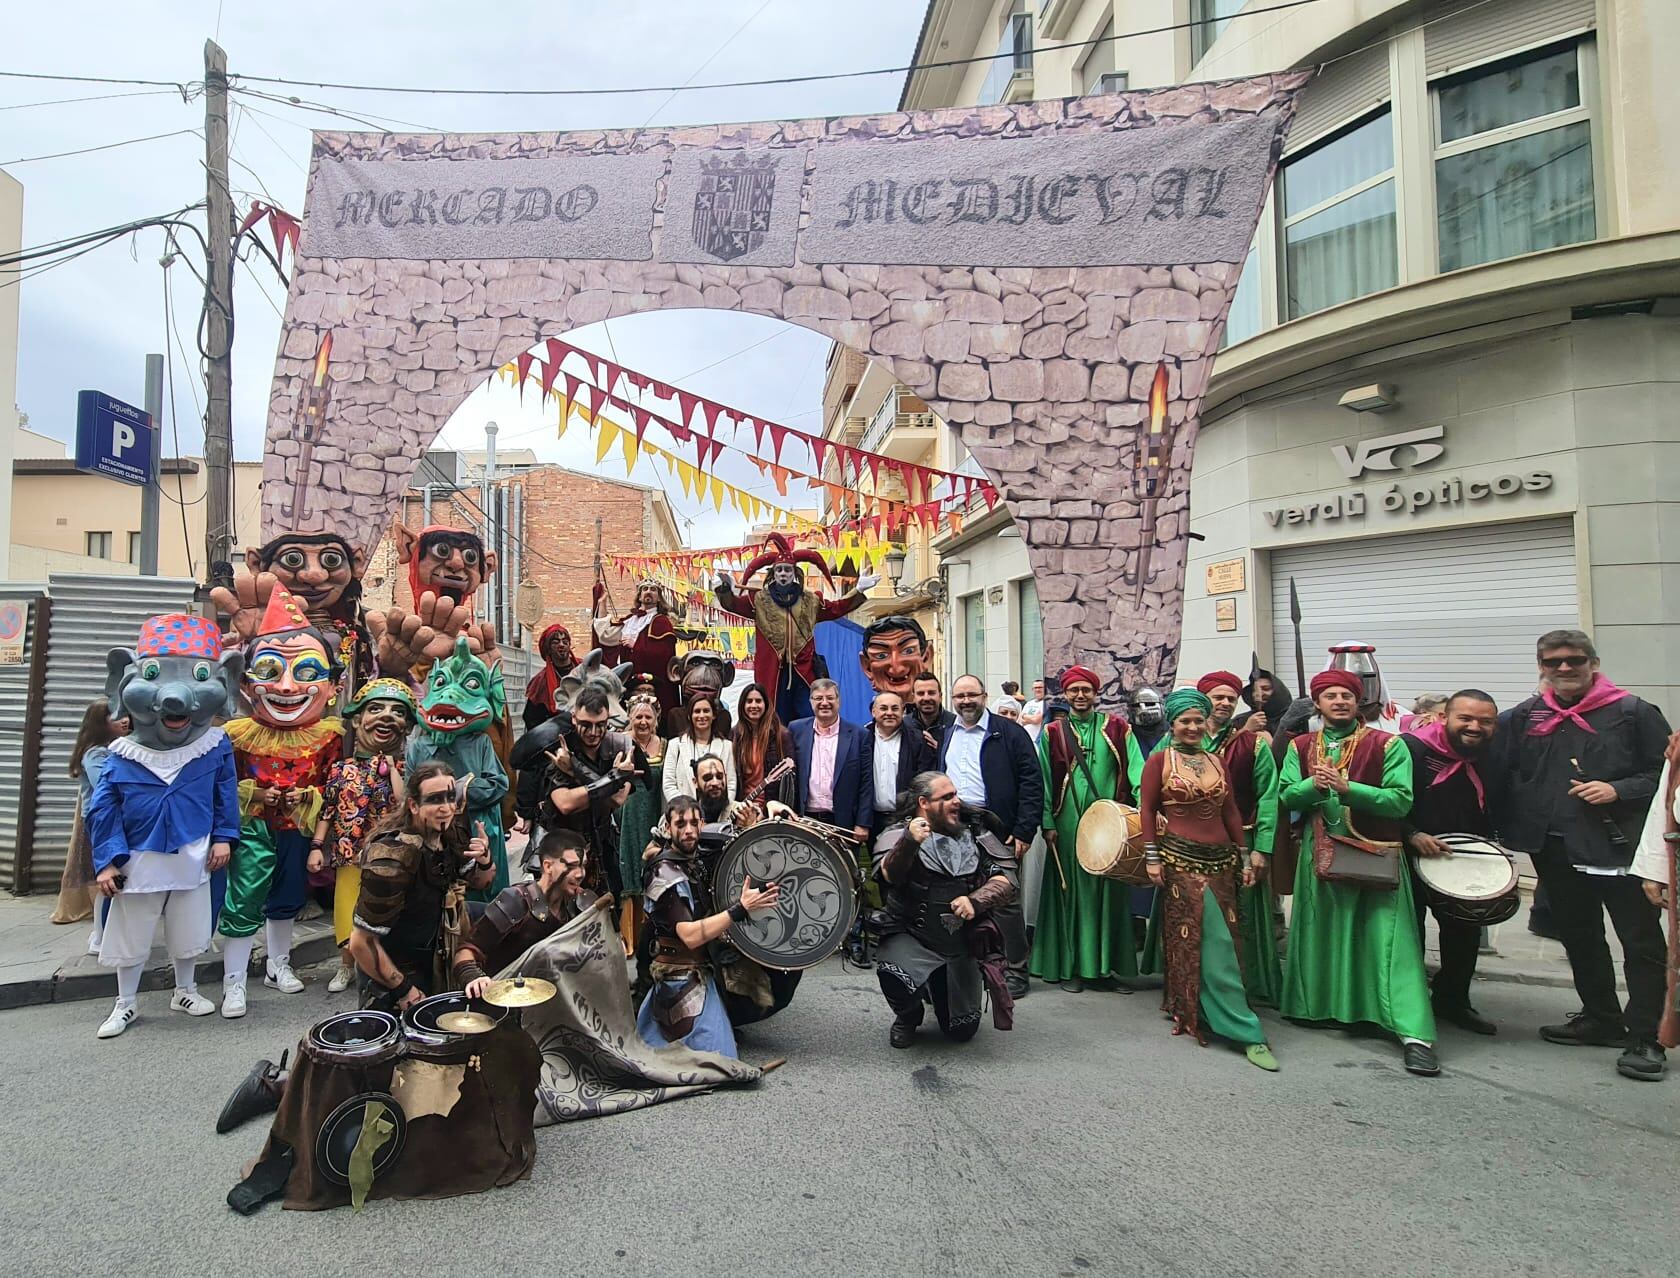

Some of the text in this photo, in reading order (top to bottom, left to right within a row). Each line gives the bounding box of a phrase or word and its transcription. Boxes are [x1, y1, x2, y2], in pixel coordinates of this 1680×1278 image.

[335, 166, 1231, 229] MERCADO MEDIEVAL
[112, 420, 135, 458] P
[98, 463, 147, 482] EXCLUSIVO CLIENTES
[101, 456, 144, 475] ESTACIONAMIENTO
[1383, 470, 1552, 513] ópticos
